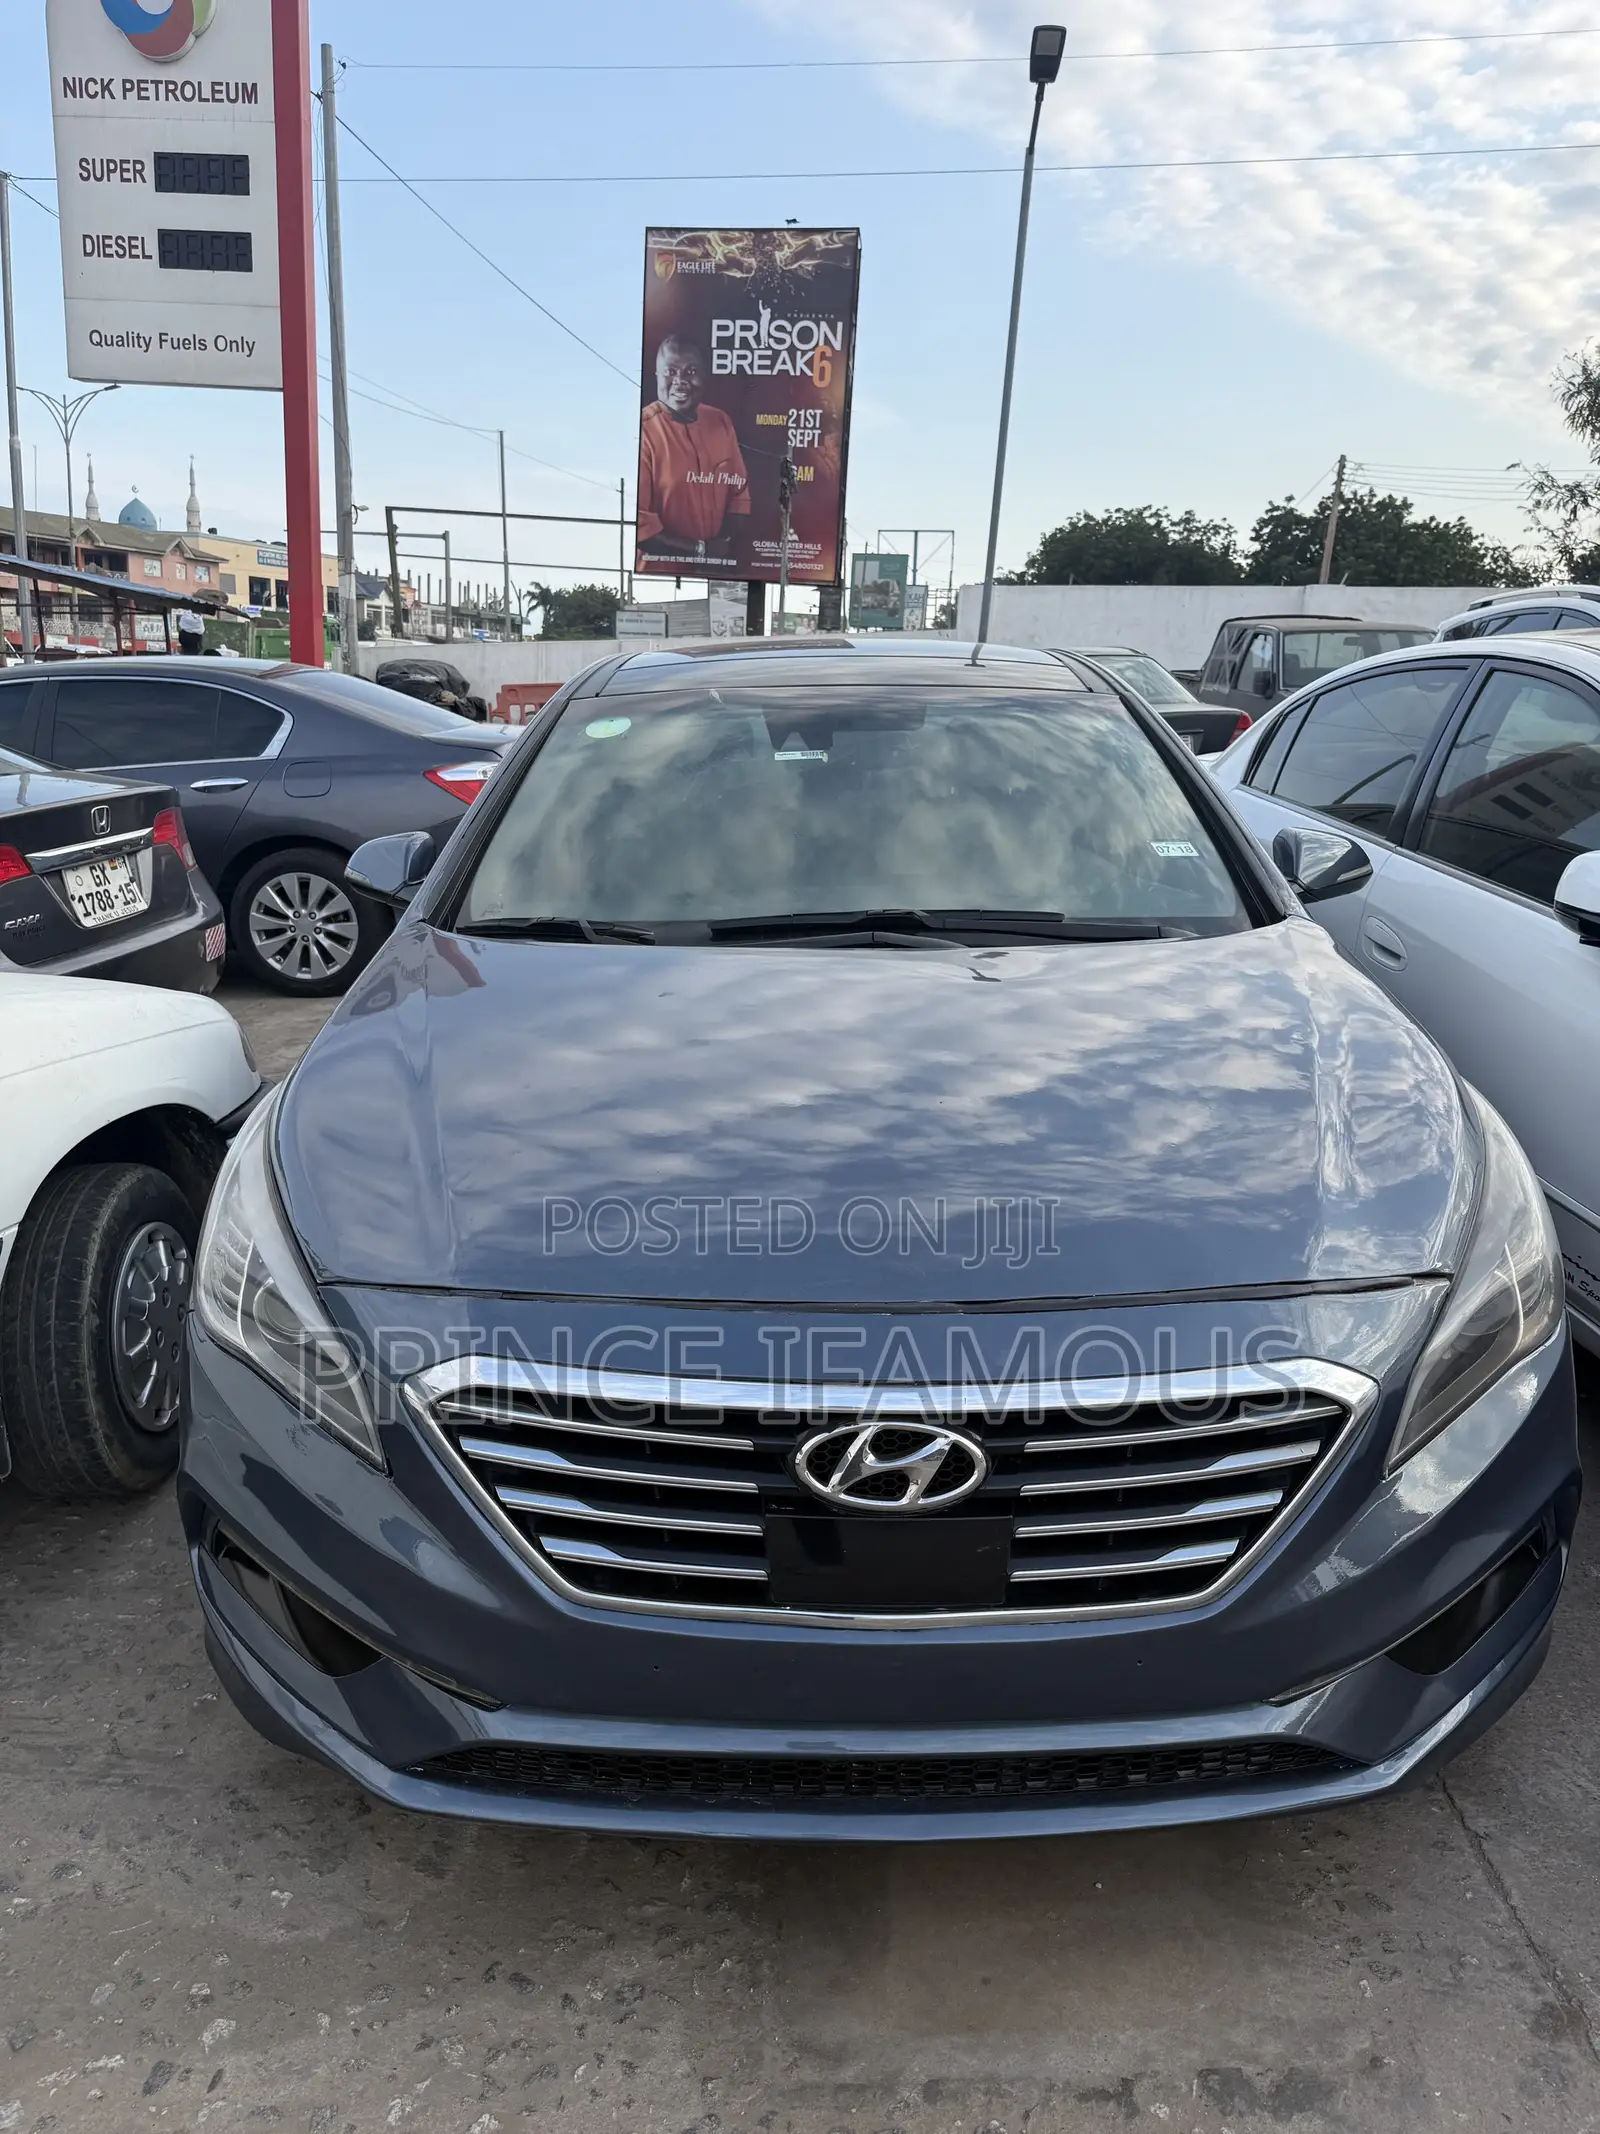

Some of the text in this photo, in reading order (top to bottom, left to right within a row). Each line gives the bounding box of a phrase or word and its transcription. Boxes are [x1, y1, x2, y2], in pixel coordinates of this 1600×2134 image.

[62, 76, 259, 105] NICK PETROLEUM
[78, 157, 148, 184] SUPER
[81, 233, 153, 260] DIESEL
[677, 261, 716, 270] EAGLE LIFE
[88, 328, 256, 358] Quality Fuels Only
[711, 318, 843, 350] PRISON
[712, 349, 815, 377] BREAK
[756, 414, 788, 426] MONDAY
[788, 408, 823, 428] 21ST
[787, 429, 822, 448] SEPT
[717, 472, 746, 489] Philip
[752, 540, 778, 548] GLOBAL
[89, 863, 111, 887] GX
[78, 883, 137, 917] 1788-15
[93, 913, 114, 924] THANK
[121, 905, 139, 915] JESUS
